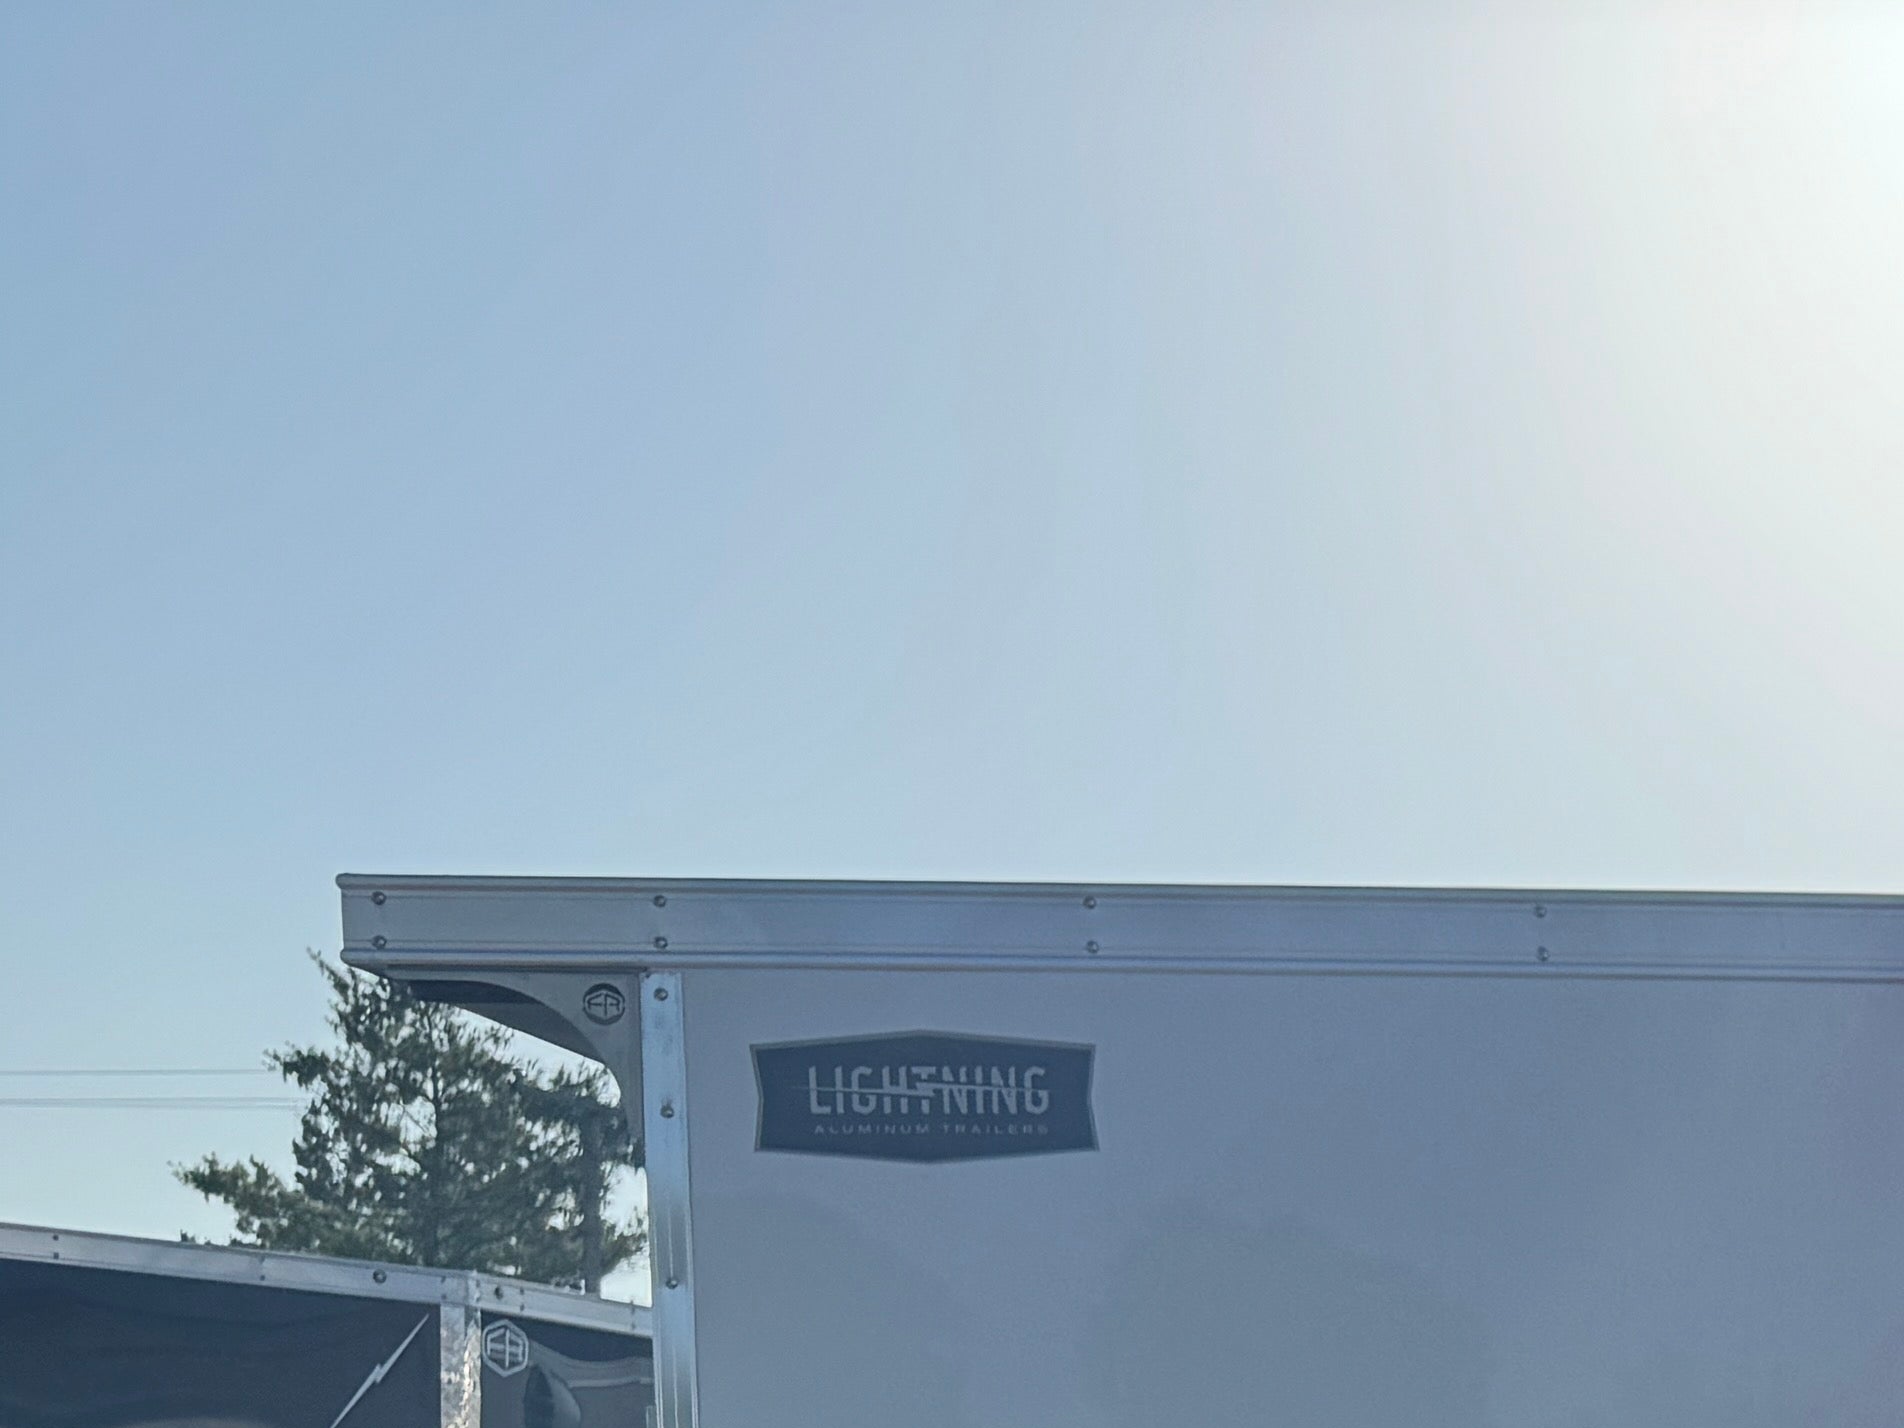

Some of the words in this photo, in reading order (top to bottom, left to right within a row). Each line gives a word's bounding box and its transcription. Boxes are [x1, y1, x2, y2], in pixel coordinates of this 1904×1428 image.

[807, 1064, 1050, 1116] LIGHTNING
[814, 1123, 930, 1136] ALUMINUM
[942, 1122, 1049, 1136] TRAILERS
